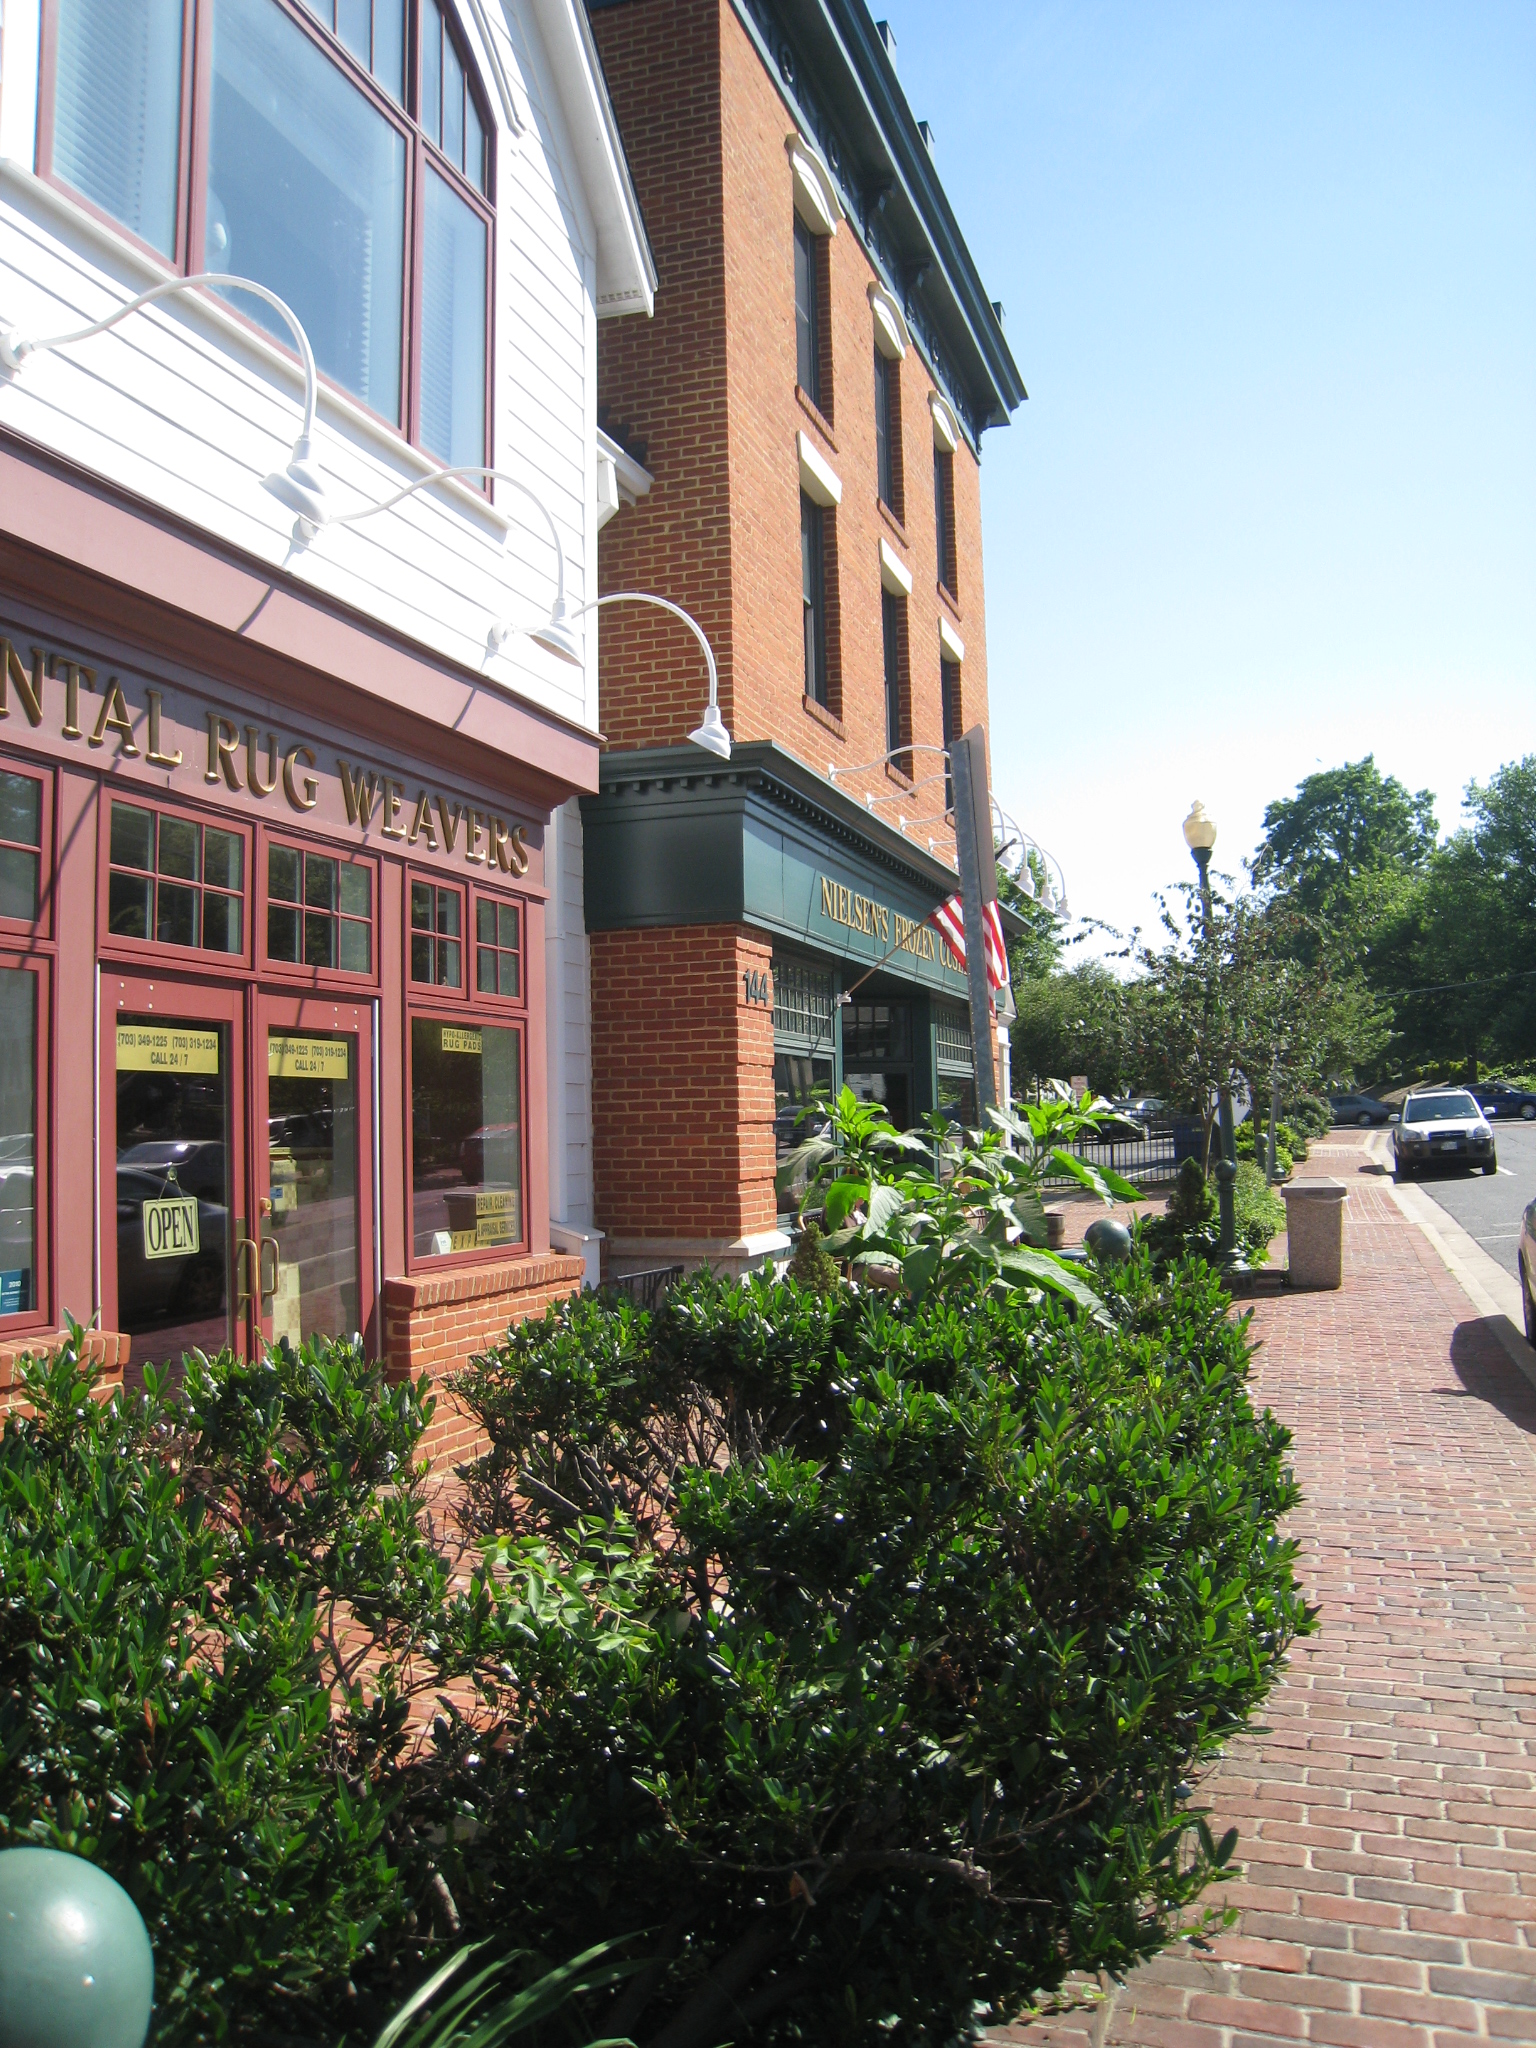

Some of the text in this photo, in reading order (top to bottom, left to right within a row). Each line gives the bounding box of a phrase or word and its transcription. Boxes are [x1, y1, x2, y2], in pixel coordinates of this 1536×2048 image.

[205, 711, 320, 812] RUG
[337, 758, 530, 878] WEAVERS
[820, 875, 889, 944] NIELSEN'S
[893, 912, 936, 963] FROZEN
[742, 968, 769, 1007] 144
[118, 1032, 217, 1050] (703) 349-1225 (703) 319-1234
[443, 1039, 482, 1051] RUG PADS
[150, 1051, 168, 1065] CALL
[169, 1053, 179, 1066] 24
[184, 1053, 189, 1066] 7
[295, 1059, 309, 1071] CALL
[309, 1060, 317, 1072] 24
[148, 1204, 194, 1251] OPEN
